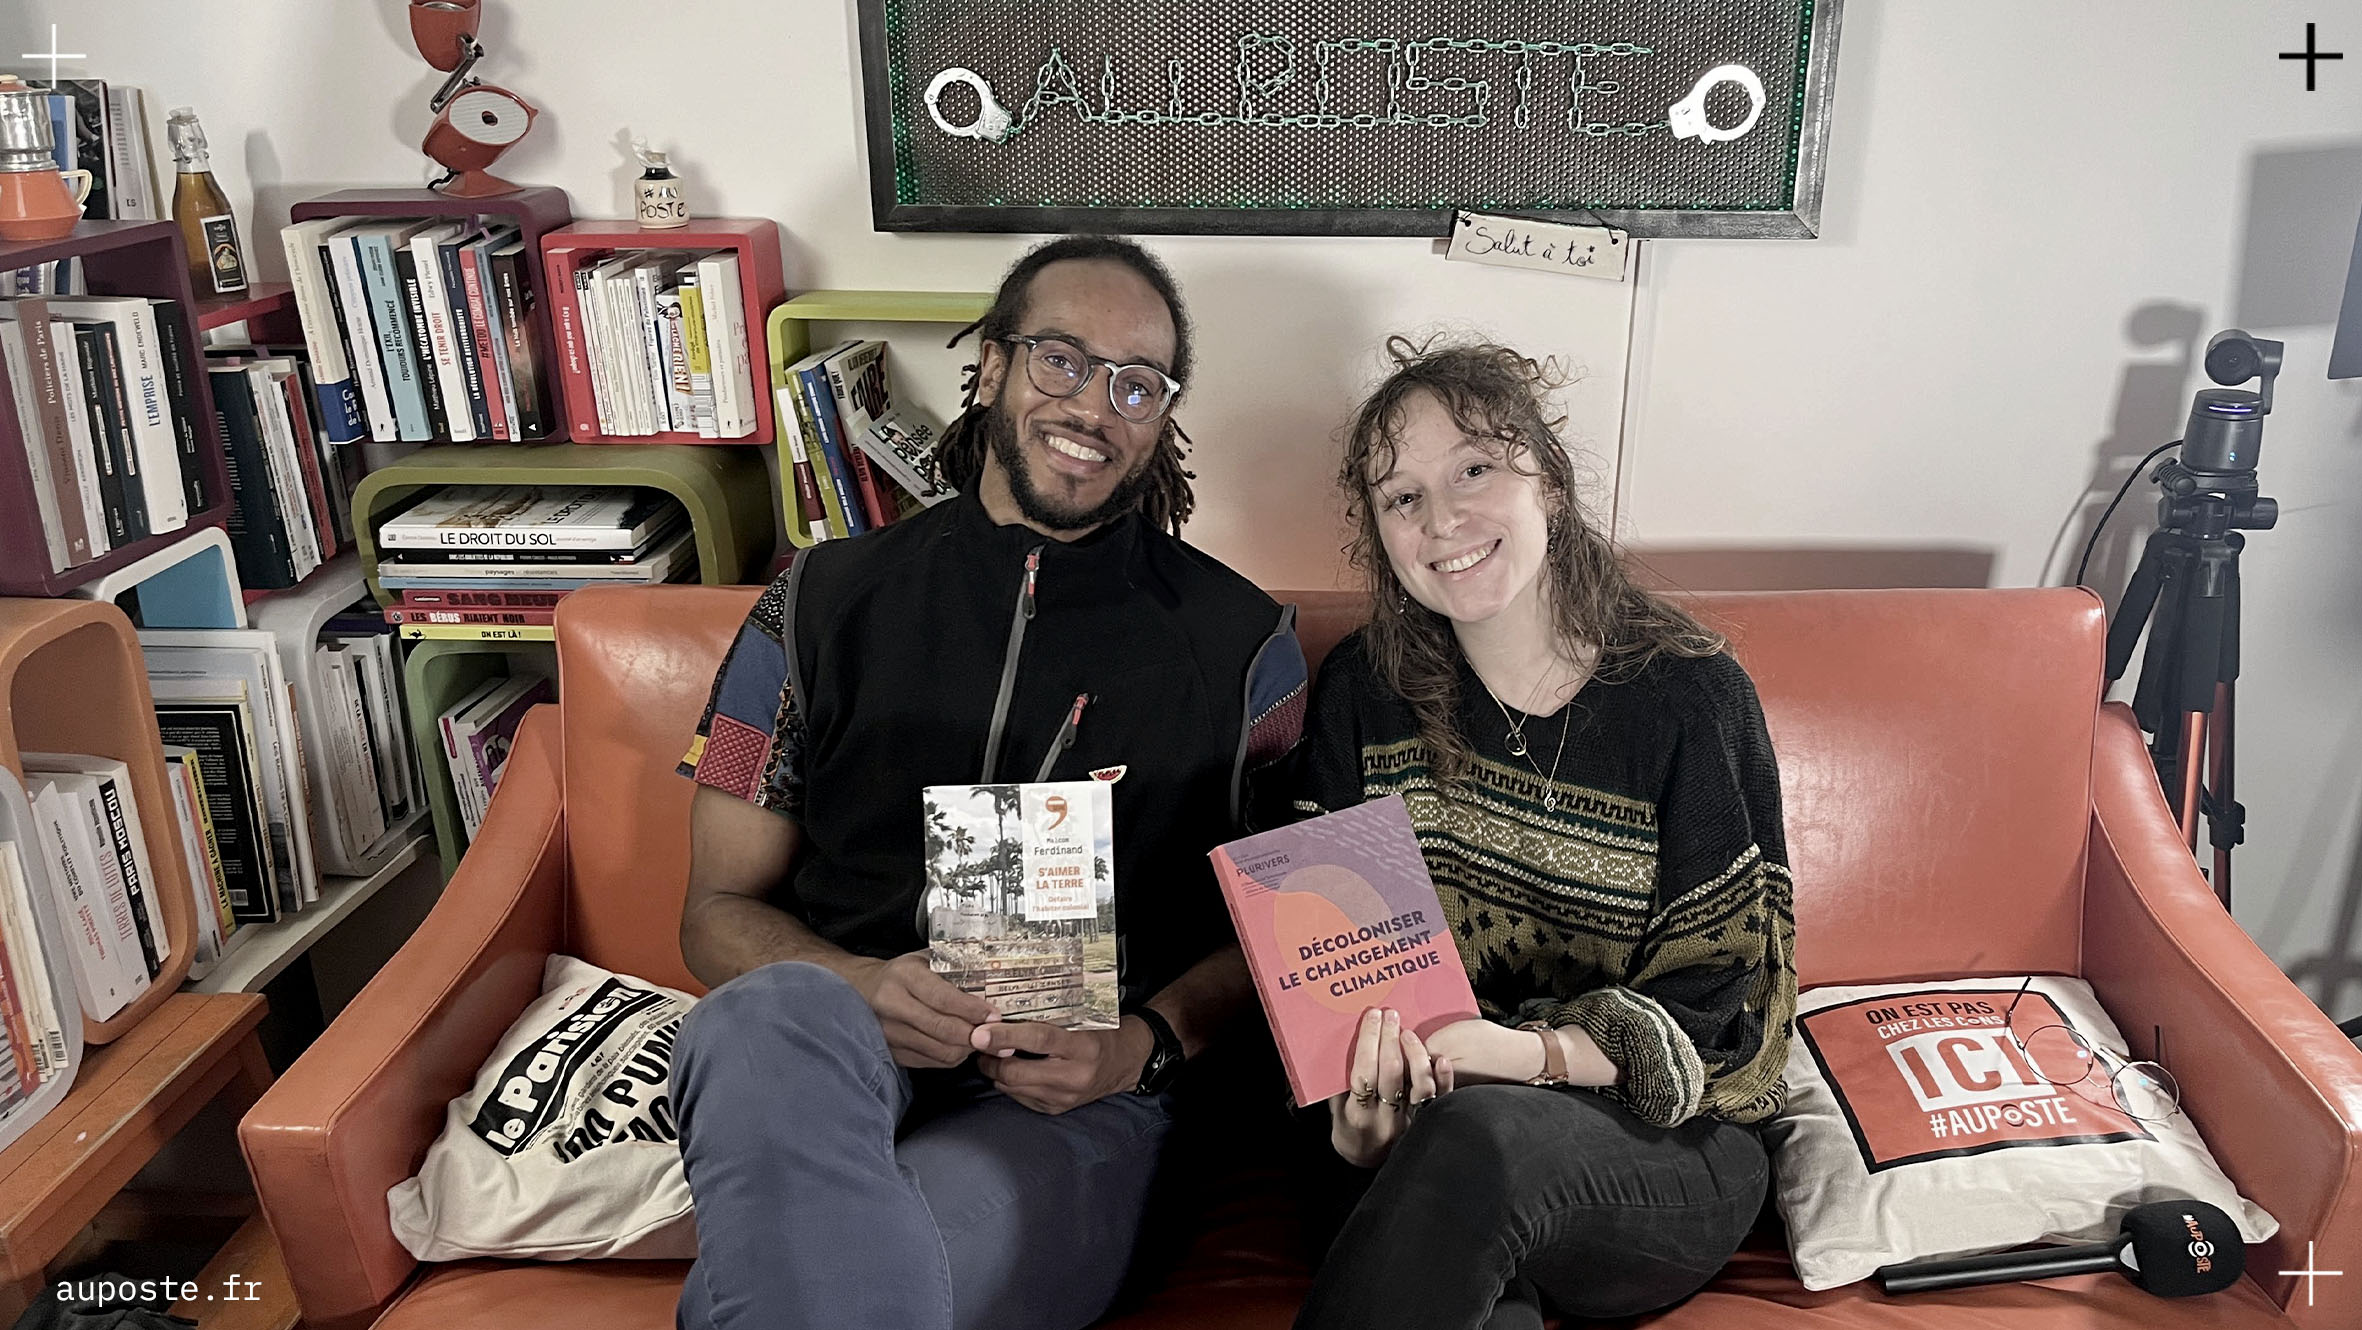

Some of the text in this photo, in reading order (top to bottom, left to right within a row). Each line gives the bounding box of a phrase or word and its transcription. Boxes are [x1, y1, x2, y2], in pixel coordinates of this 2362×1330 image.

[640, 201, 685, 219] POSTE
[1465, 226, 1595, 267] Salut à toi
[432, 312, 451, 365] SE TENIR DROIT
[35, 321, 56, 403] Policiers de Paris
[132, 312, 160, 426] L'EMPRISE MARC ENDEWELD
[440, 533, 456, 545] LE
[459, 532, 502, 546] DROIT
[505, 533, 527, 546] DU
[529, 533, 557, 546] SOL
[411, 612, 427, 622] LES
[429, 610, 461, 623] BÉRUS
[502, 612, 526, 623] NOIR
[106, 788, 139, 895] PARIS MOSCOU
[205, 829, 216, 858] GAGNER
[1034, 845, 1083, 856] Ferdinand
[214, 865, 225, 897] MACHINE
[1038, 866, 1081, 877] S'AIMER
[1236, 854, 1290, 877] PLURIVERS
[100, 851, 132, 941] TERRES DE LUTTES
[1036, 878, 1084, 890] LA TERRE
[220, 897, 228, 908] LA
[1298, 910, 1426, 961] DÉCOLONISER
[1279, 930, 1431, 991] LE CHANGEMENT
[1329, 951, 1441, 998] CLIMATIQUE
[1865, 1001, 1995, 1025] ON EST PAS
[1876, 1018, 1921, 1040] CHEZ
[1924, 1016, 1955, 1029] LES
[485, 987, 643, 1149] le Parisien
[1900, 1035, 2041, 1100] ICI
[1929, 1097, 2078, 1138] #AUPOSTE
